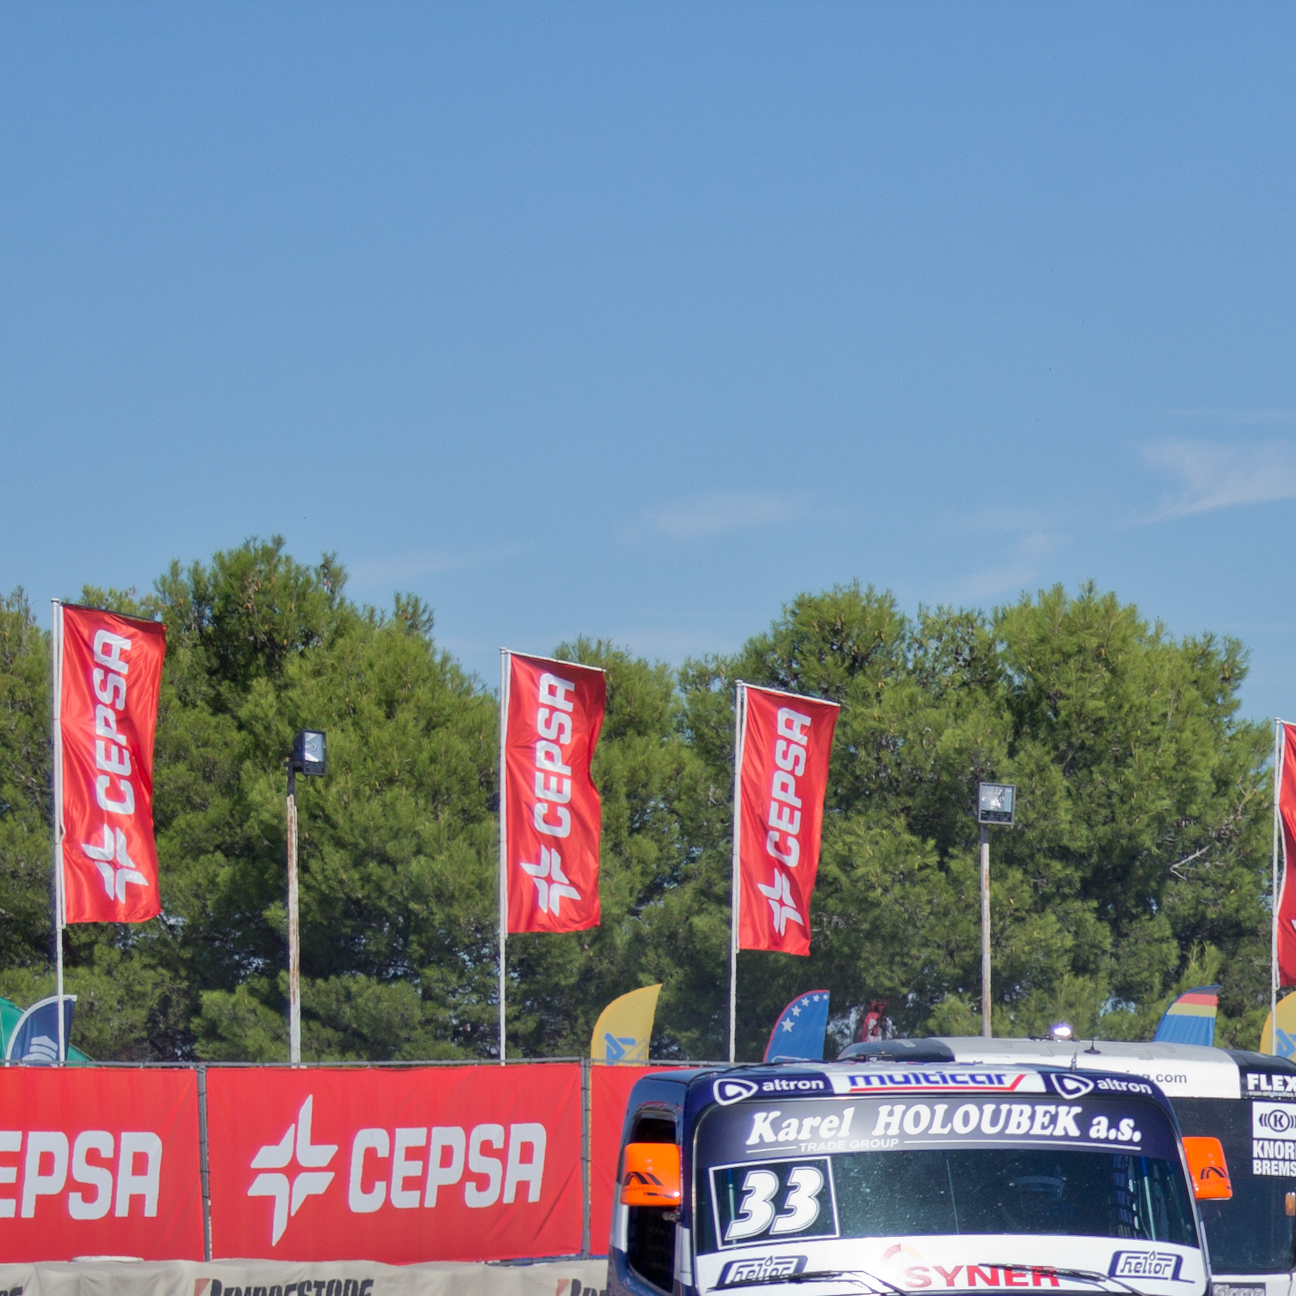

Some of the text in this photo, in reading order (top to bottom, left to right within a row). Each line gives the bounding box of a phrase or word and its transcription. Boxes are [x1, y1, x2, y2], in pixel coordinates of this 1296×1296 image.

[93, 629, 134, 816] CEPSA
[534, 672, 575, 838] CEPSA
[766, 707, 812, 868] CEPSA
[746, 1103, 1143, 1146] Karel HOLOUBEK a.s.
[762, 1079, 825, 1093] altron
[1097, 1078, 1153, 1095] altron
[0, 1130, 163, 1221] EPSA
[347, 1122, 548, 1214] CEPSA
[799, 1138, 900, 1153] TRADE GROUP
[724, 1165, 825, 1242] 33
